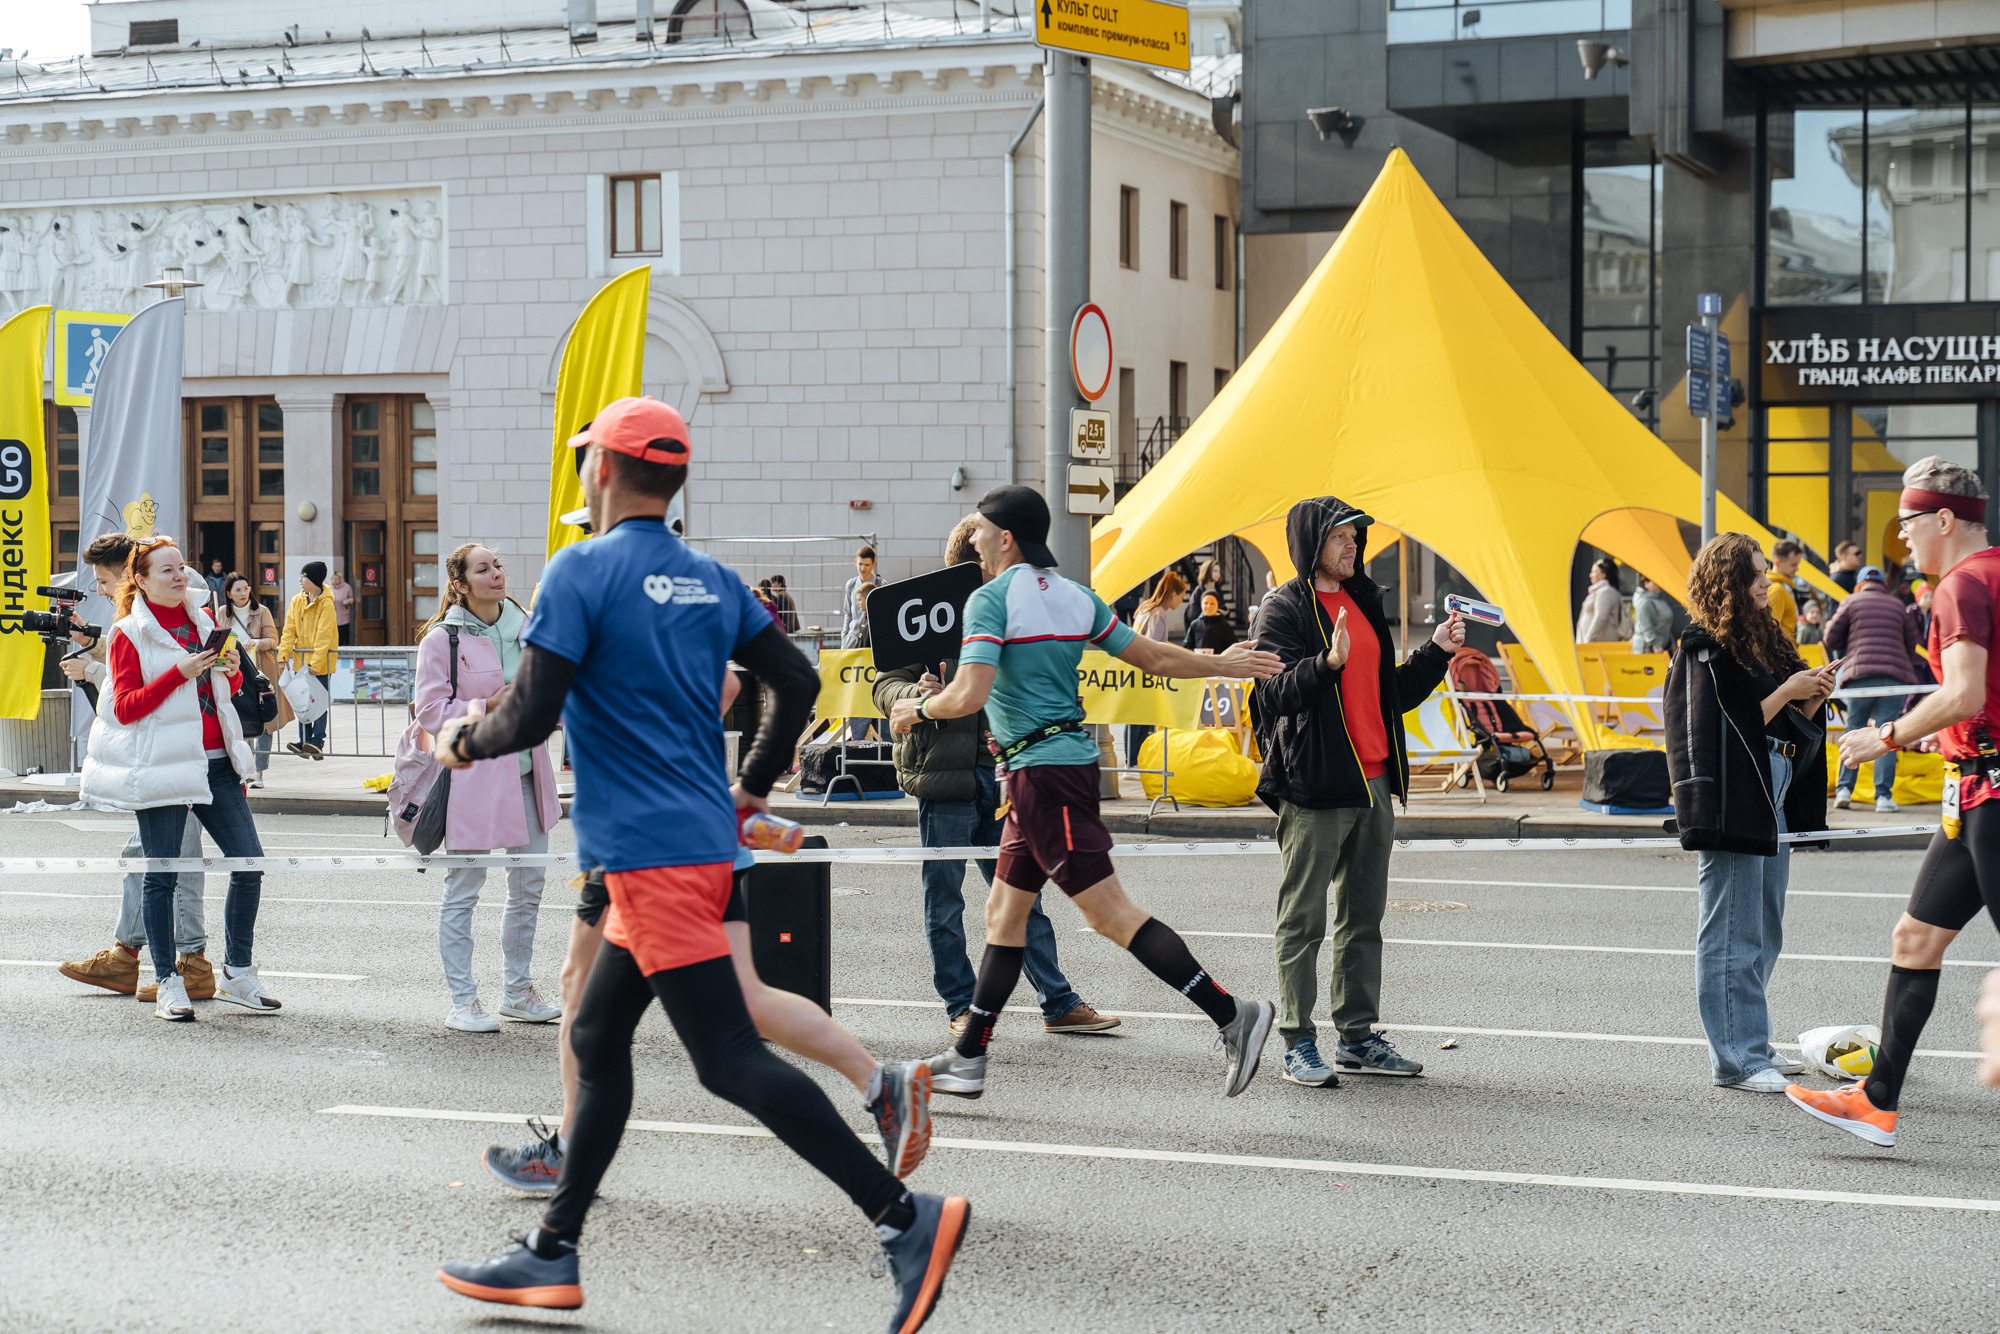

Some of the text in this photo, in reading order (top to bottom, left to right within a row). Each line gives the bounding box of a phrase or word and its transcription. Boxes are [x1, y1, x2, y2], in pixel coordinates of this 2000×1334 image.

[1057, 0, 1118, 23] КУЛЬТ CULT
[1057, 21, 1170, 52] комплекс премиум-класса
[1174, 31, 1186, 46] 1.3
[1925, 364, 2000, 384] ПЕКАР
[0, 509, 28, 636] Яндекс
[897, 598, 955, 642] Go
